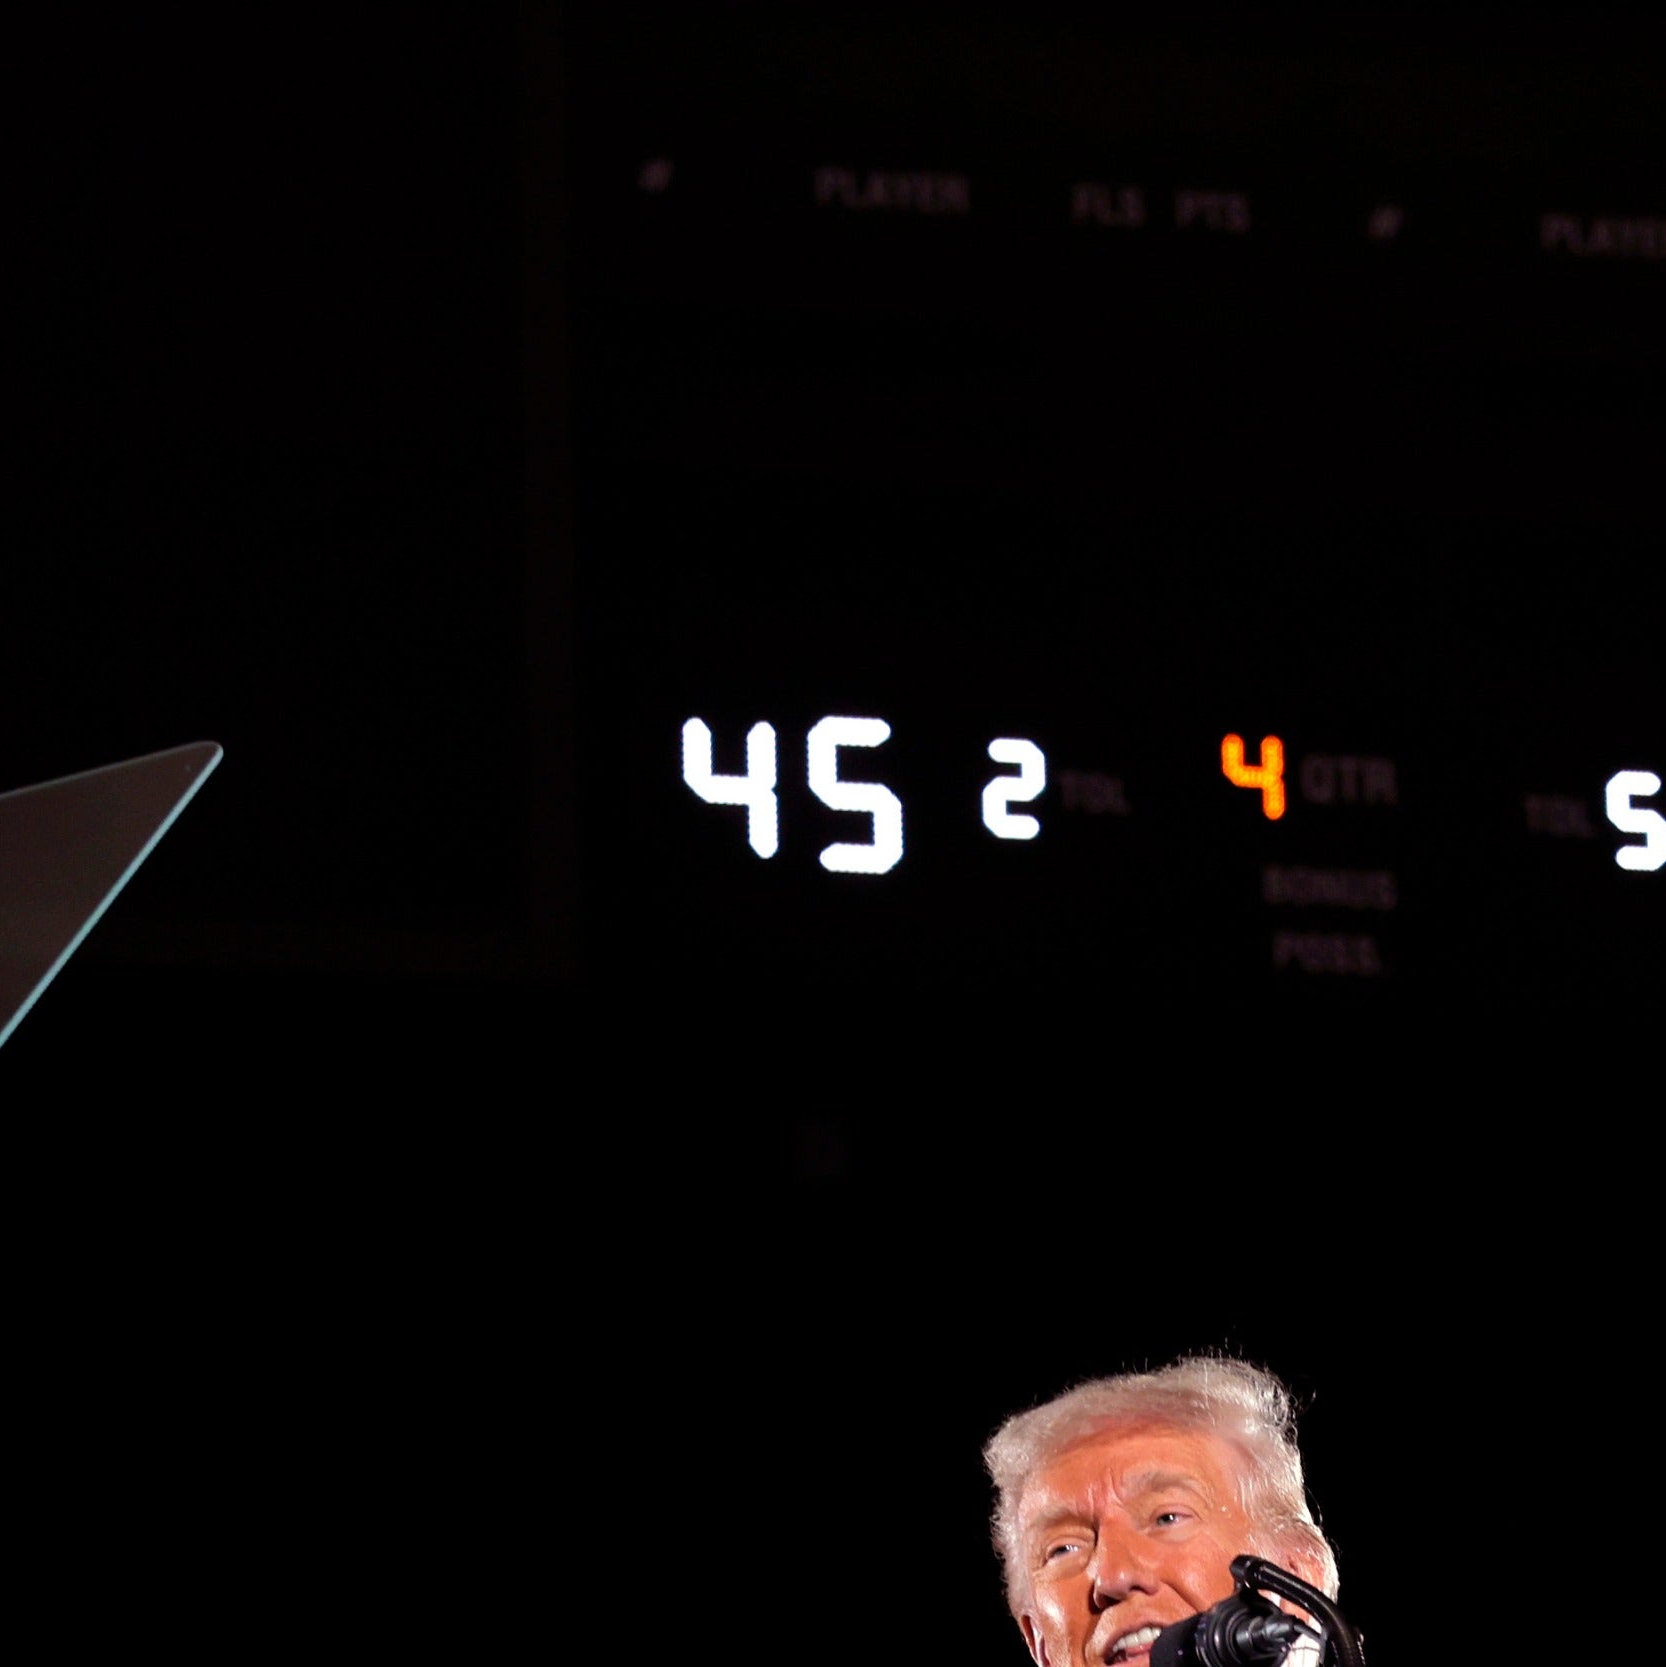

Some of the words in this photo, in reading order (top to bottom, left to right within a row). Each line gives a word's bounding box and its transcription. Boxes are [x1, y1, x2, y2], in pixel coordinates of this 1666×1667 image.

[813, 165, 971, 215] PLAYER
[1174, 189, 1251, 234] PTS
[681, 715, 904, 875] 45
[981, 737, 1047, 840] 2
[1220, 733, 1287, 821] 4
[1298, 752, 1399, 806] QTR
[1261, 863, 1398, 911] BONUS
